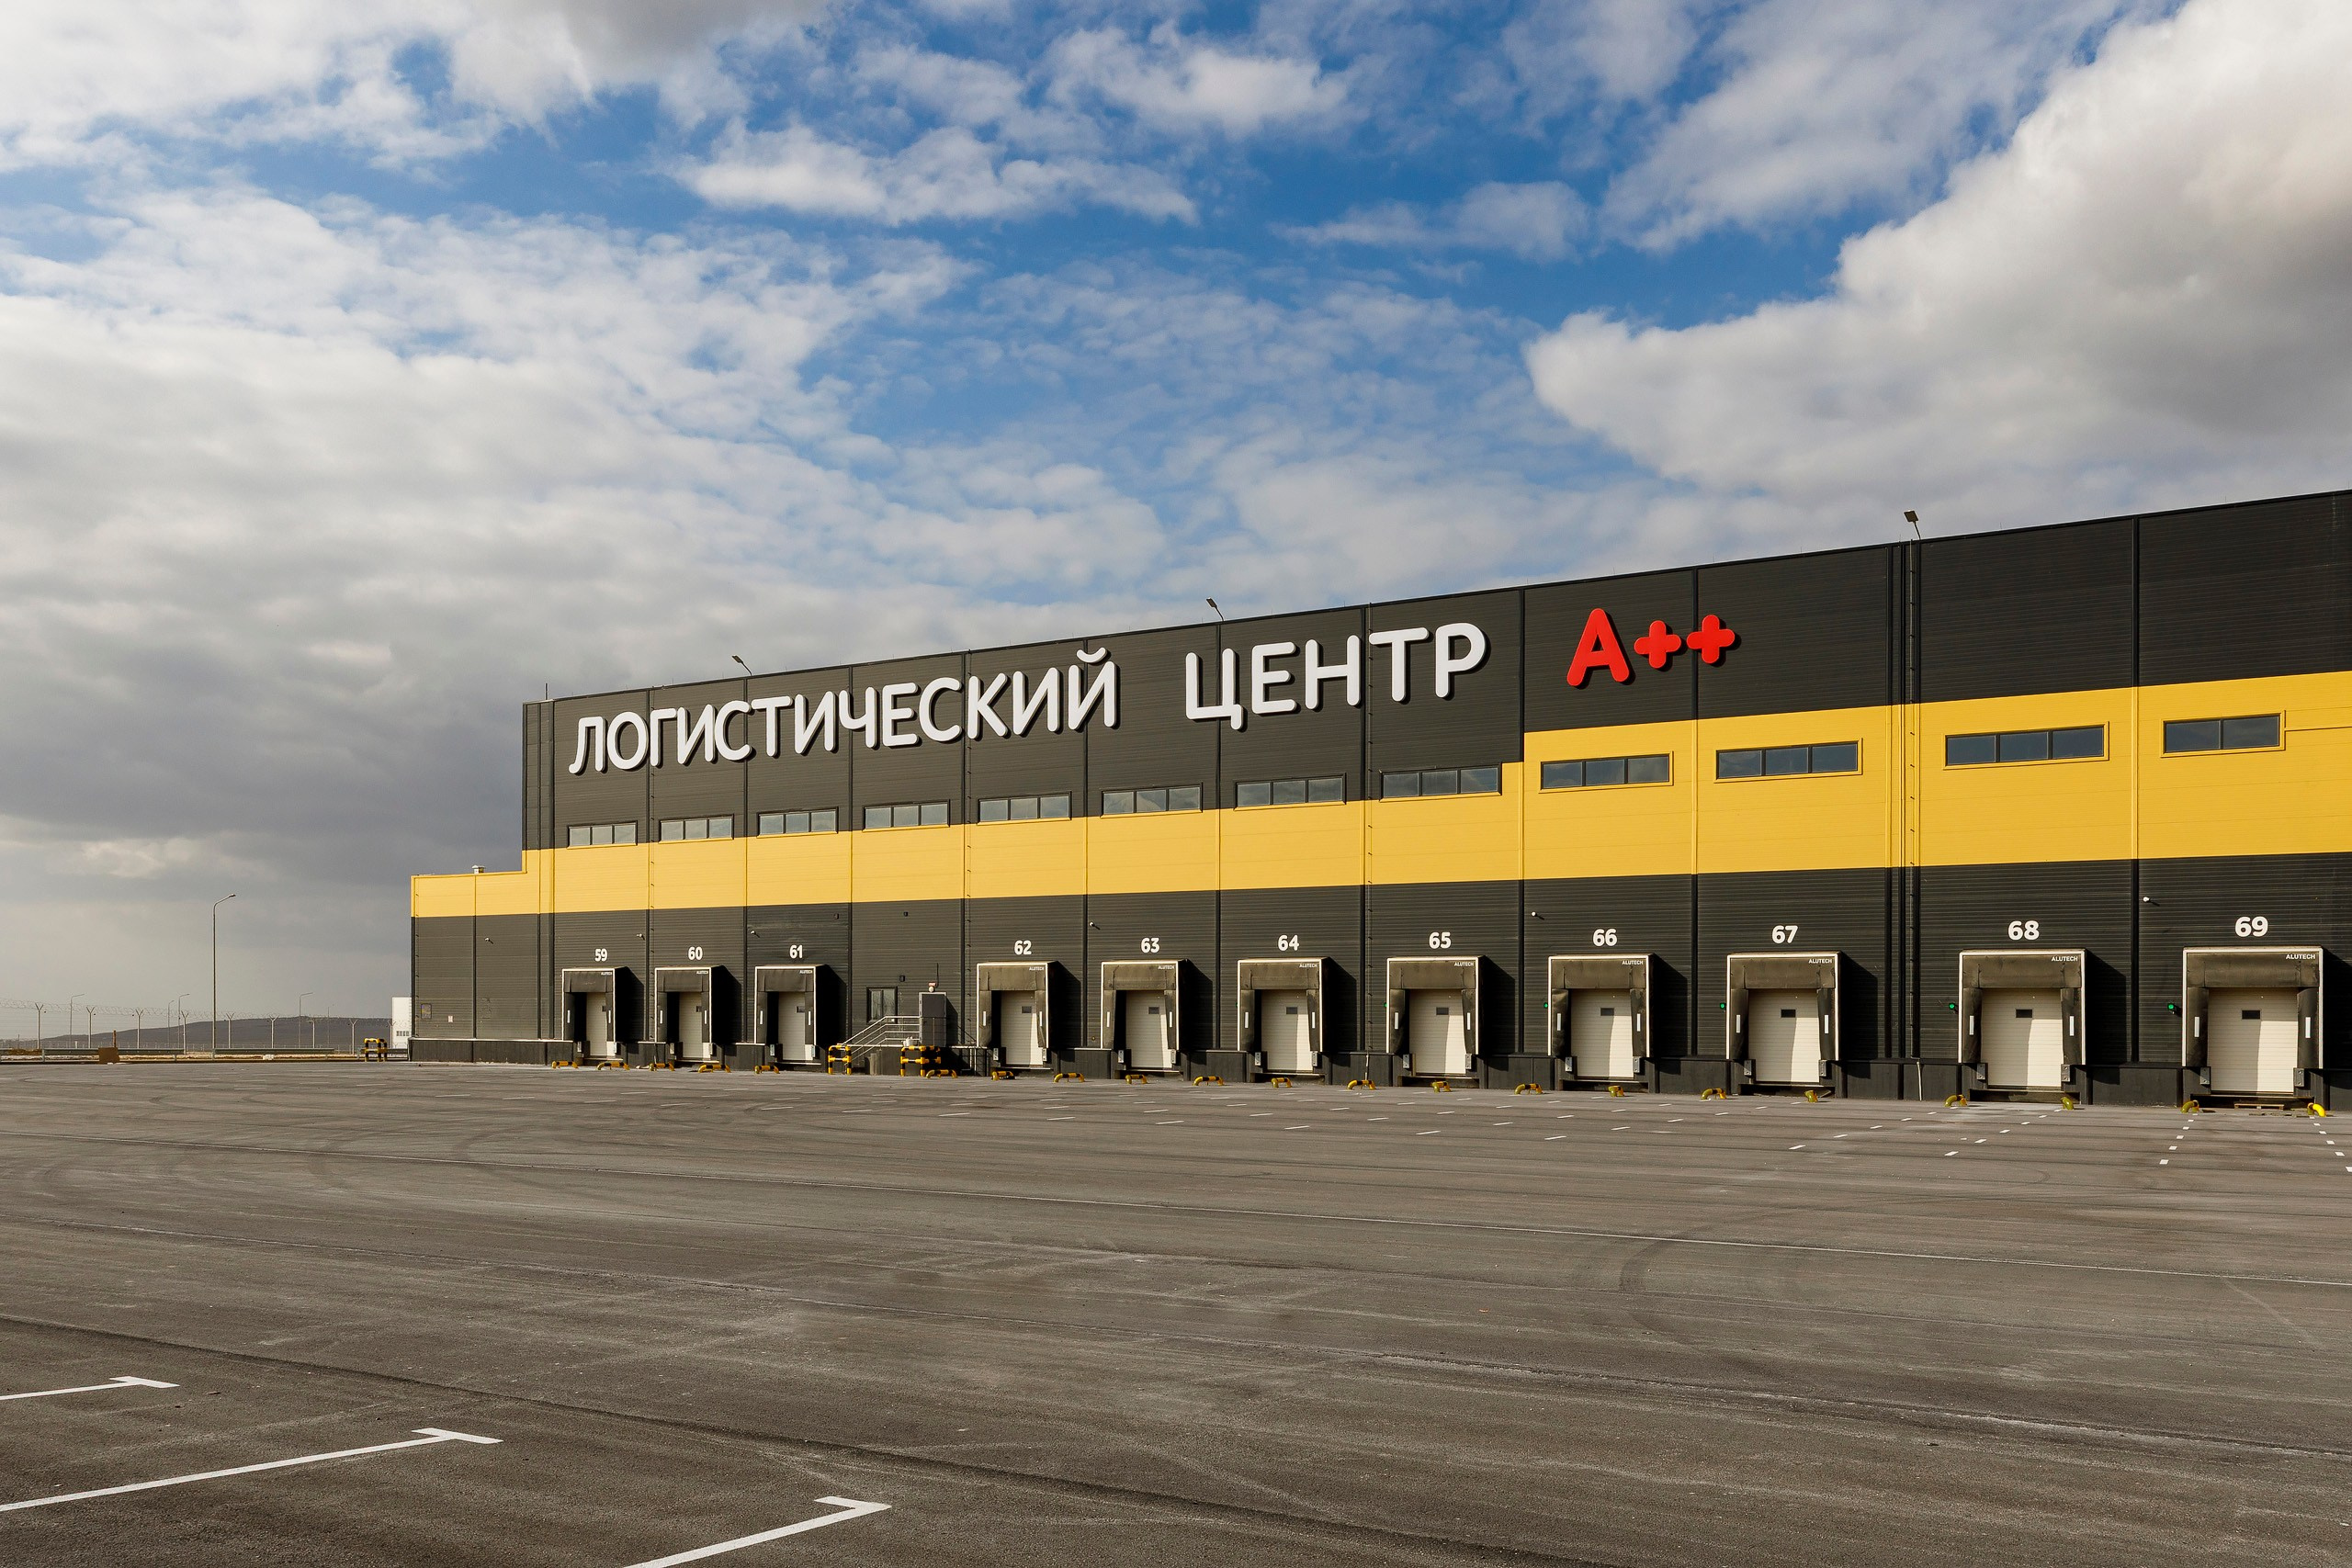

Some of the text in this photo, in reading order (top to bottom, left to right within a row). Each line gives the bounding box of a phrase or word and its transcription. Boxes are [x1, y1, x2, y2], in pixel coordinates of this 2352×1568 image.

[568, 647, 1115, 774] ЛОГИСТИЧЕСКИЙ
[1185, 622, 1487, 730] ЦЕНТР
[1771, 925, 1799, 944] 67
[2007, 919, 2040, 941] 68
[2234, 916, 2268, 938] 69
[1140, 937, 1160, 953] 63
[1277, 934, 1300, 952] 64
[1429, 931, 1452, 950] 65
[1592, 928, 1618, 947] 66
[594, 948, 608, 962] 59
[687, 946, 704, 961] 60
[789, 944, 803, 959] 61
[1013, 940, 1032, 955] 62
